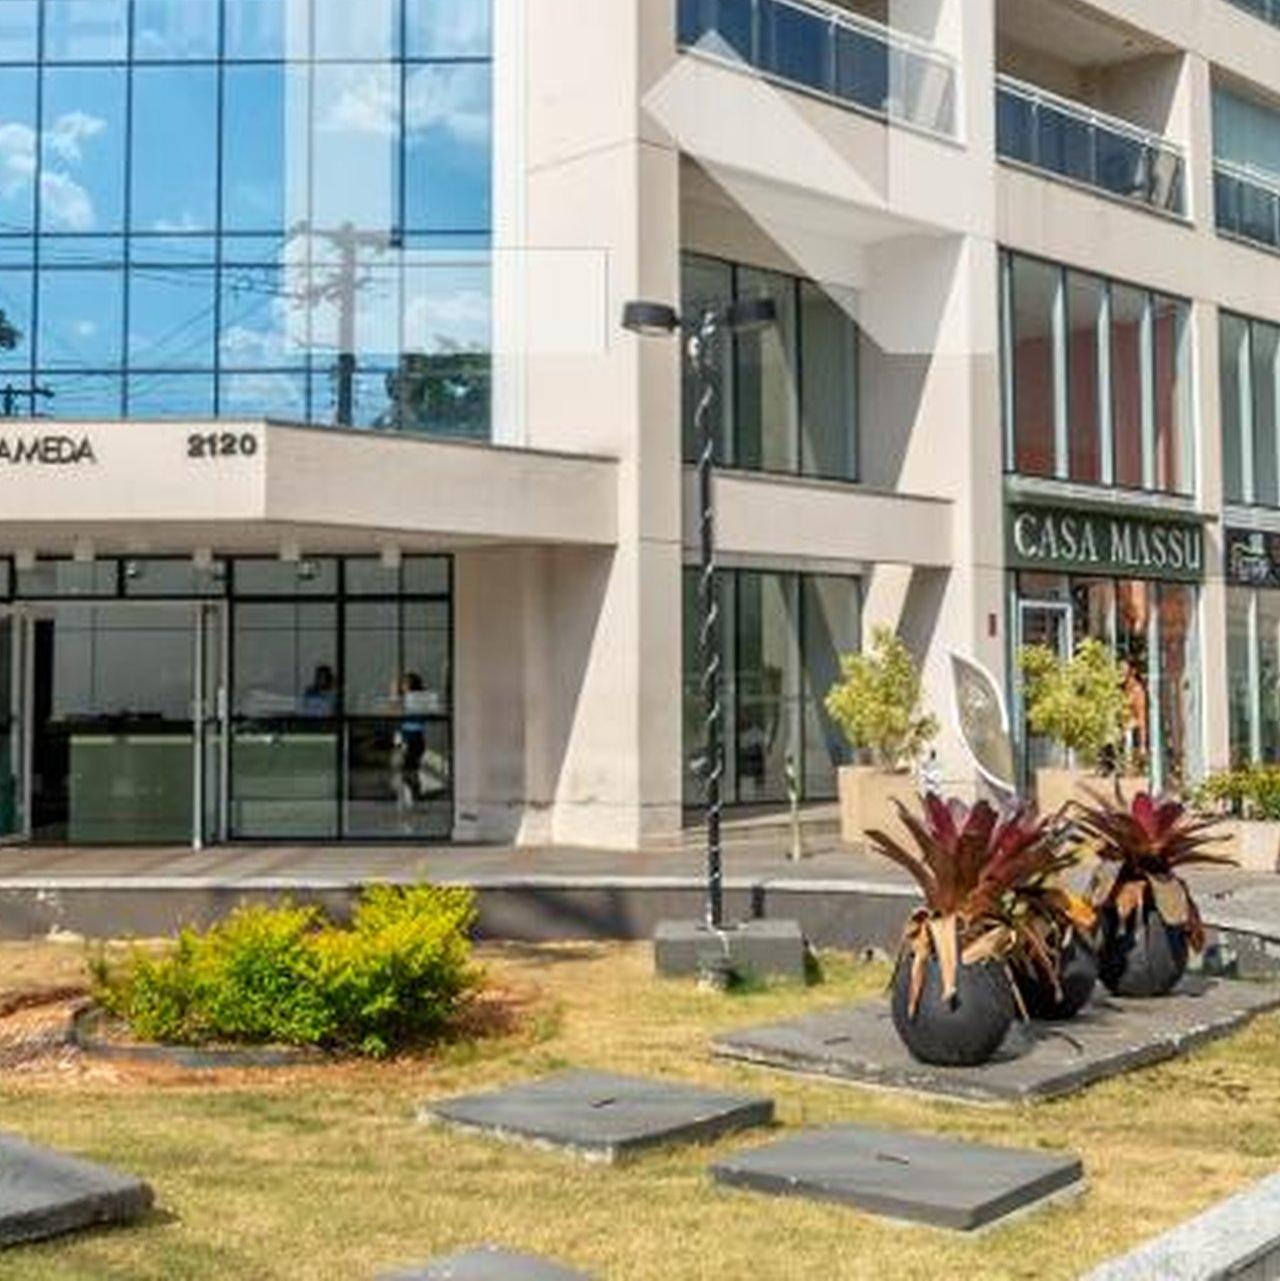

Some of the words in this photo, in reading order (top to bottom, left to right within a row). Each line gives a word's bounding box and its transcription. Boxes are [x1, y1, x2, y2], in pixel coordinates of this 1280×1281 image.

[187, 432, 258, 459] 2120
[1014, 511, 1100, 562] CASA
[1109, 520, 1201, 569] MASSU
